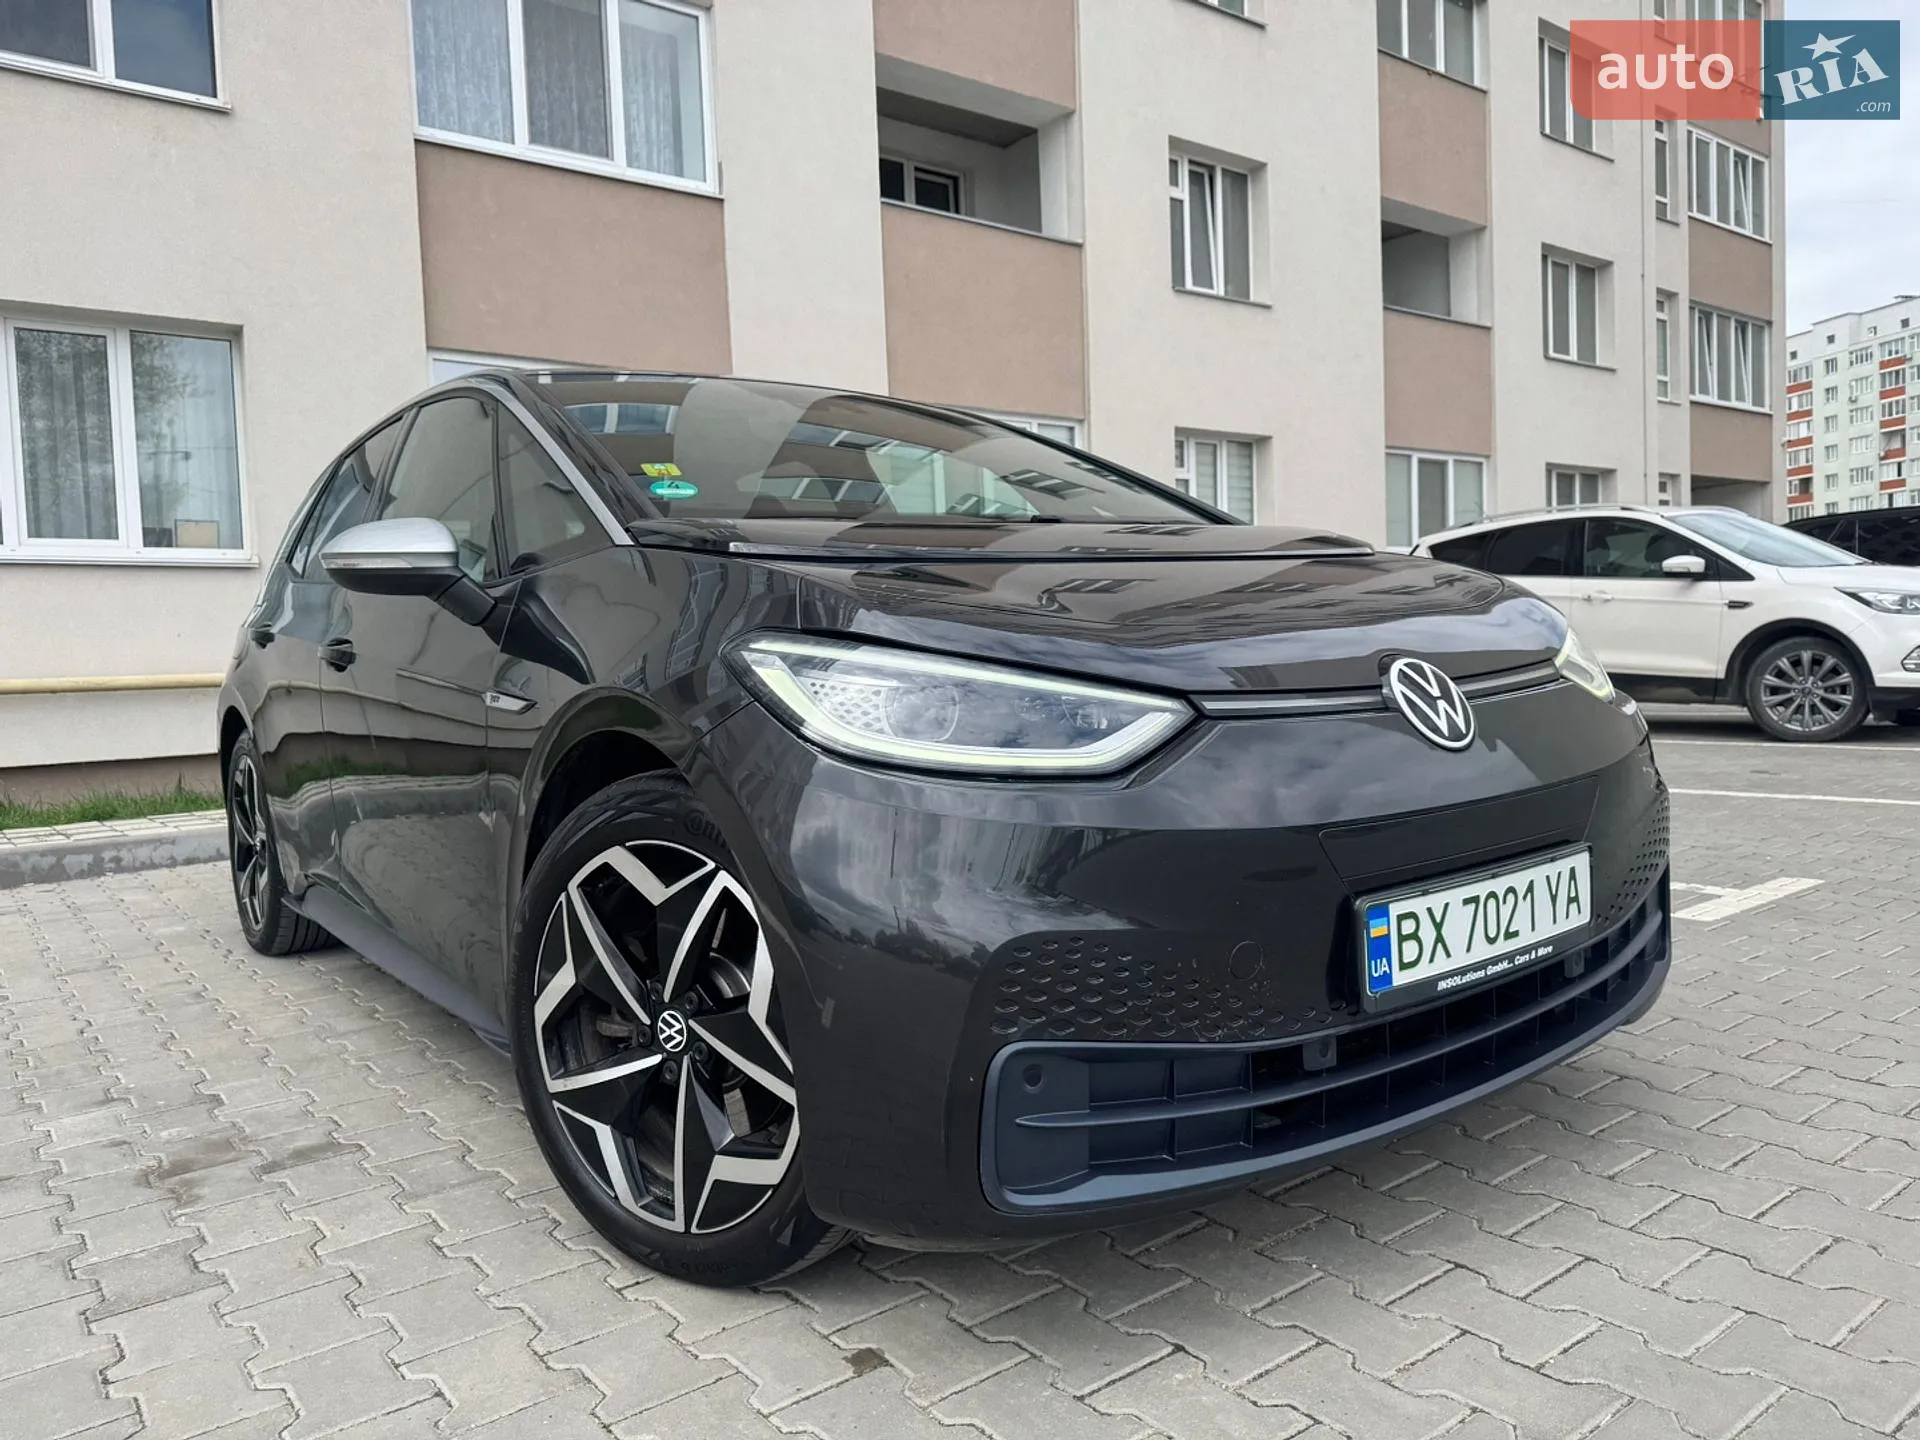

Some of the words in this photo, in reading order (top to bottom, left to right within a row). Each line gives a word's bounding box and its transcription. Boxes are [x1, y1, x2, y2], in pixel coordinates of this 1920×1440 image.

[1396, 902, 1452, 972] BX
[1462, 879, 1536, 953] 7021
[1545, 865, 1582, 925] YA
[1371, 957, 1391, 978] UA
[1514, 953, 1530, 966] Cars
